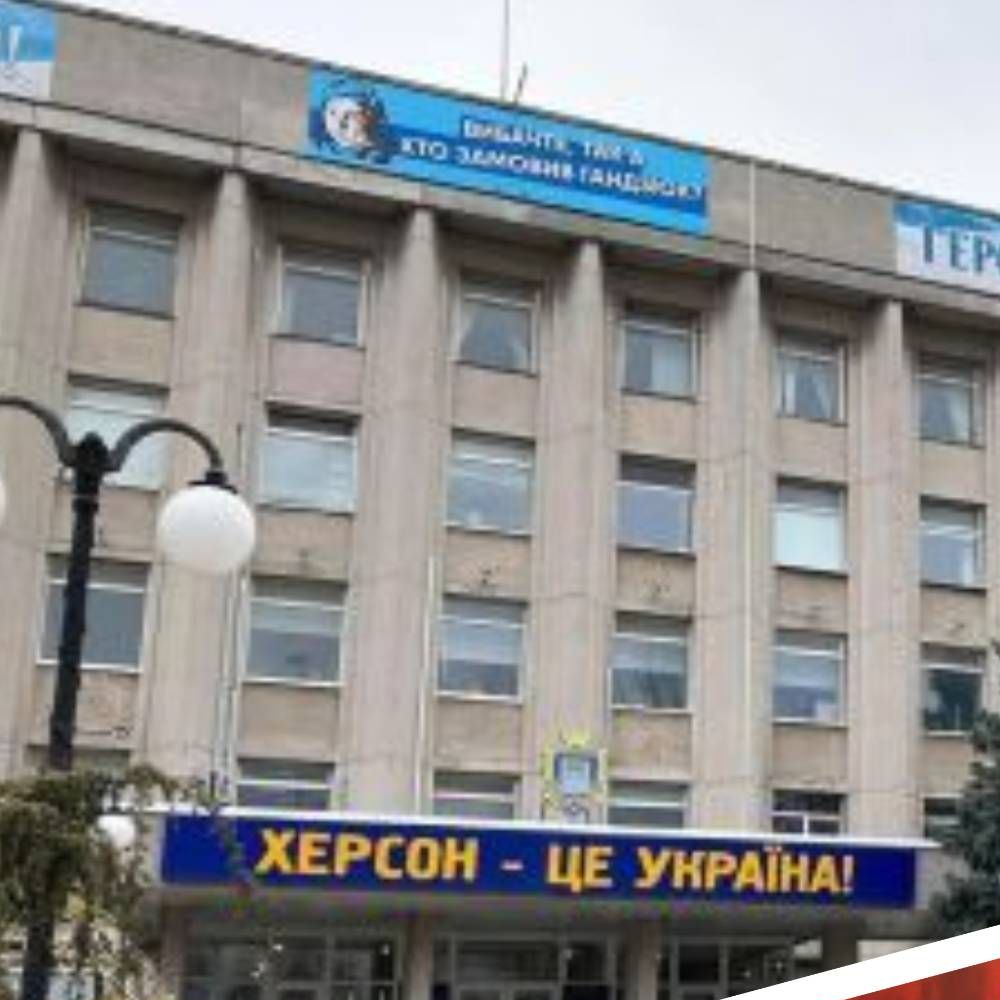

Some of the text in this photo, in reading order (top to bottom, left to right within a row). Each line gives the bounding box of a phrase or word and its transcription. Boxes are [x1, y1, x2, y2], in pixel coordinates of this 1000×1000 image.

[254, 828, 854, 894] ХЕРСОН - ЦЕ УКРАЇНА!
